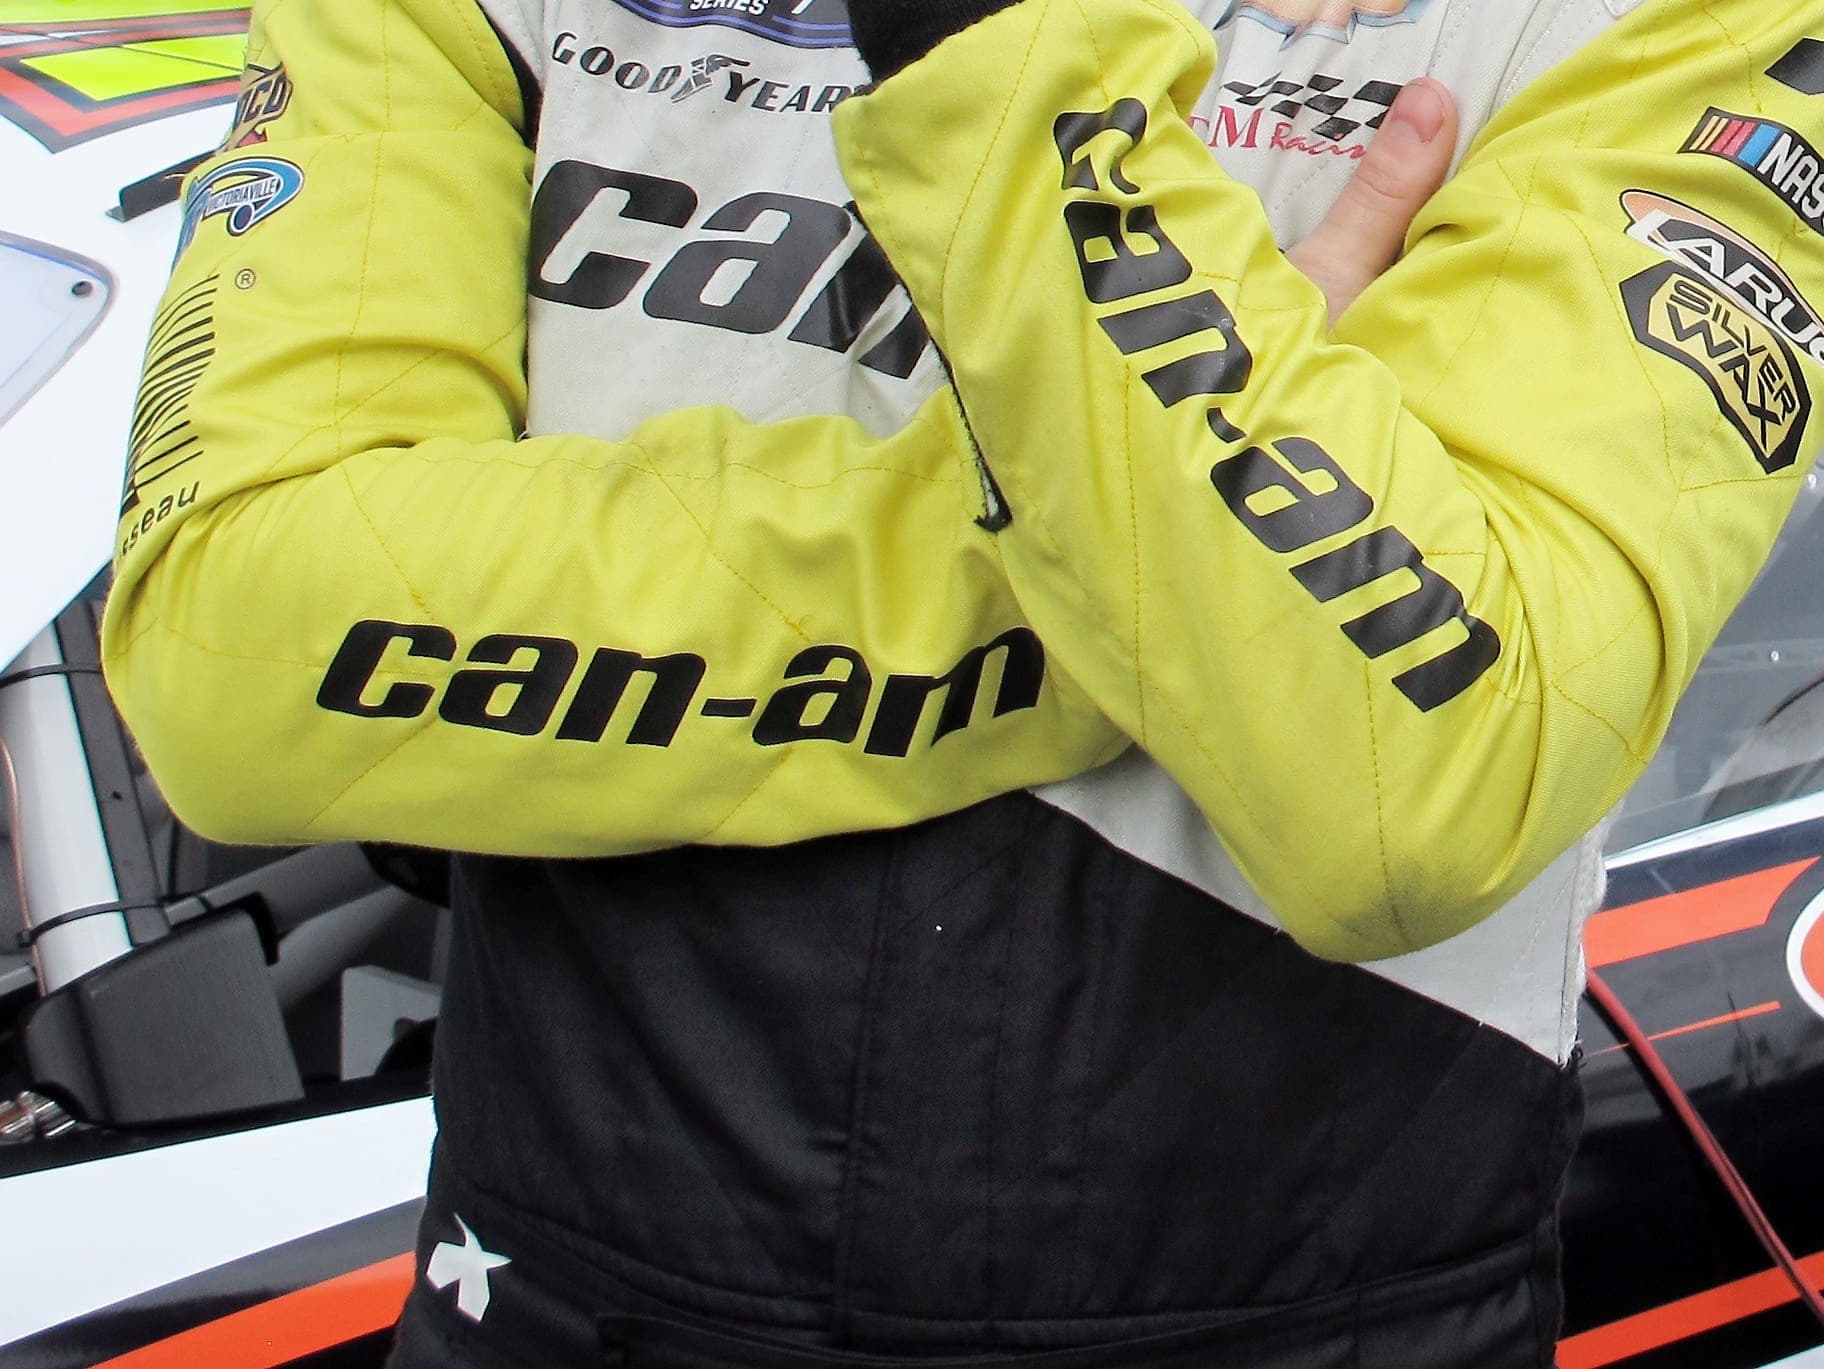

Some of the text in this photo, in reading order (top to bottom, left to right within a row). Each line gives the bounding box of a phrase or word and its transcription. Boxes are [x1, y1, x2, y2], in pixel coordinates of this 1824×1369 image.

[1053, 97, 1501, 714] can-am
[1665, 302, 1784, 451] WAX
[1669, 279, 1797, 421] SILVER
[316, 618, 1046, 758] can-am
